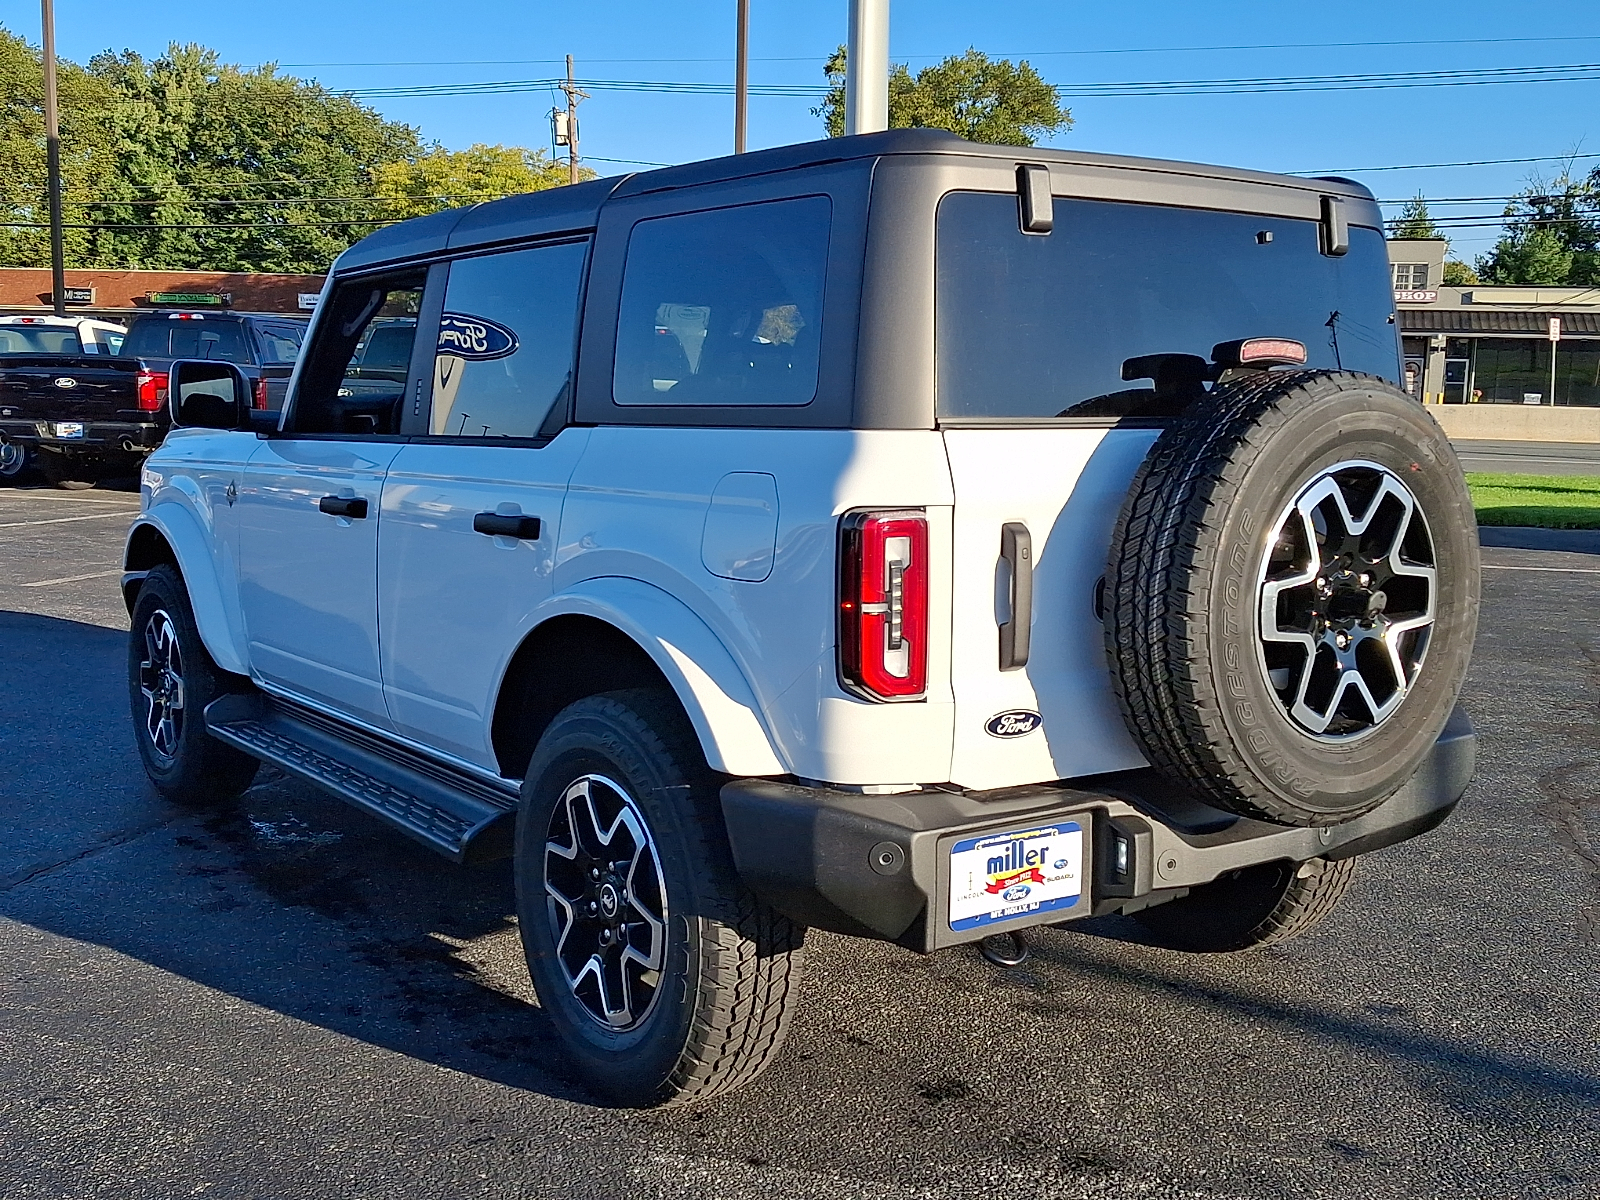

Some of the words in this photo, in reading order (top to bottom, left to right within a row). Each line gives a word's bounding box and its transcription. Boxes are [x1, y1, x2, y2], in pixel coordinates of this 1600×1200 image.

[1219, 507, 1321, 798] BRIDGESTONE
[995, 712, 1035, 735] Ford
[986, 840, 1049, 875] miller
[1046, 873, 1074, 883] SUBARU
[957, 891, 985, 902] LINCOLN
[1005, 887, 1028, 901] Ford
